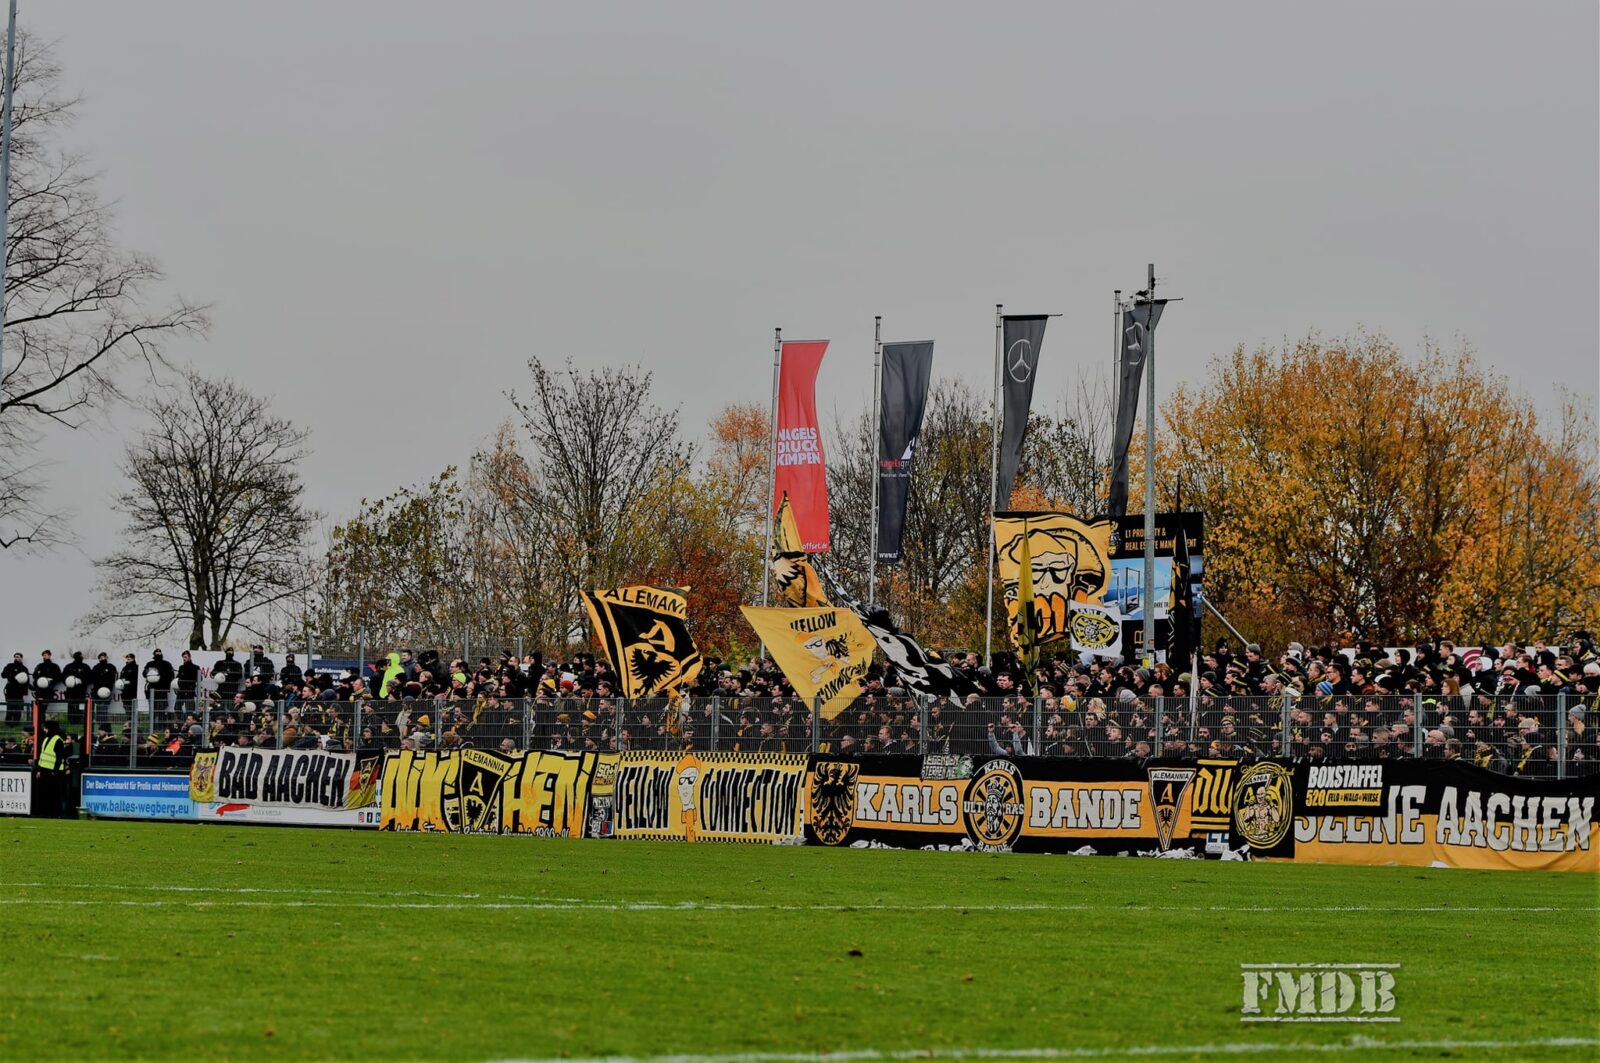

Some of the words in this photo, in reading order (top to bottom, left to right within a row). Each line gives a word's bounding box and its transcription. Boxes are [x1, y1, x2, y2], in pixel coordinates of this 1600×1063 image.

[779, 427, 817, 441] NAGELS
[777, 452, 821, 466] KIMPEN
[1132, 527, 1161, 538] PROTY
[1125, 541, 1139, 551] REAL
[1139, 540, 1159, 550] ESE
[1159, 538, 1197, 549] MANAENT
[790, 611, 837, 633] YELLOW
[463, 751, 507, 772] ALEMANNIA
[984, 761, 1016, 775] KARLS
[218, 751, 263, 799] BAD
[262, 753, 350, 808] AACHEN
[1152, 772, 1190, 781] ALEMANNIA
[1307, 764, 1384, 789] BOXSTAFFEL
[615, 765, 676, 830] YELLOW
[856, 782, 959, 826] KARLS
[1030, 786, 1142, 829] BANDE
[1305, 789, 1326, 807] 520
[86, 800, 189, 817] www.baltes-wegberg.eu
[963, 801, 984, 813] ULT
[1004, 803, 1025, 815] RAS
[1436, 785, 1594, 856] AACHEN
